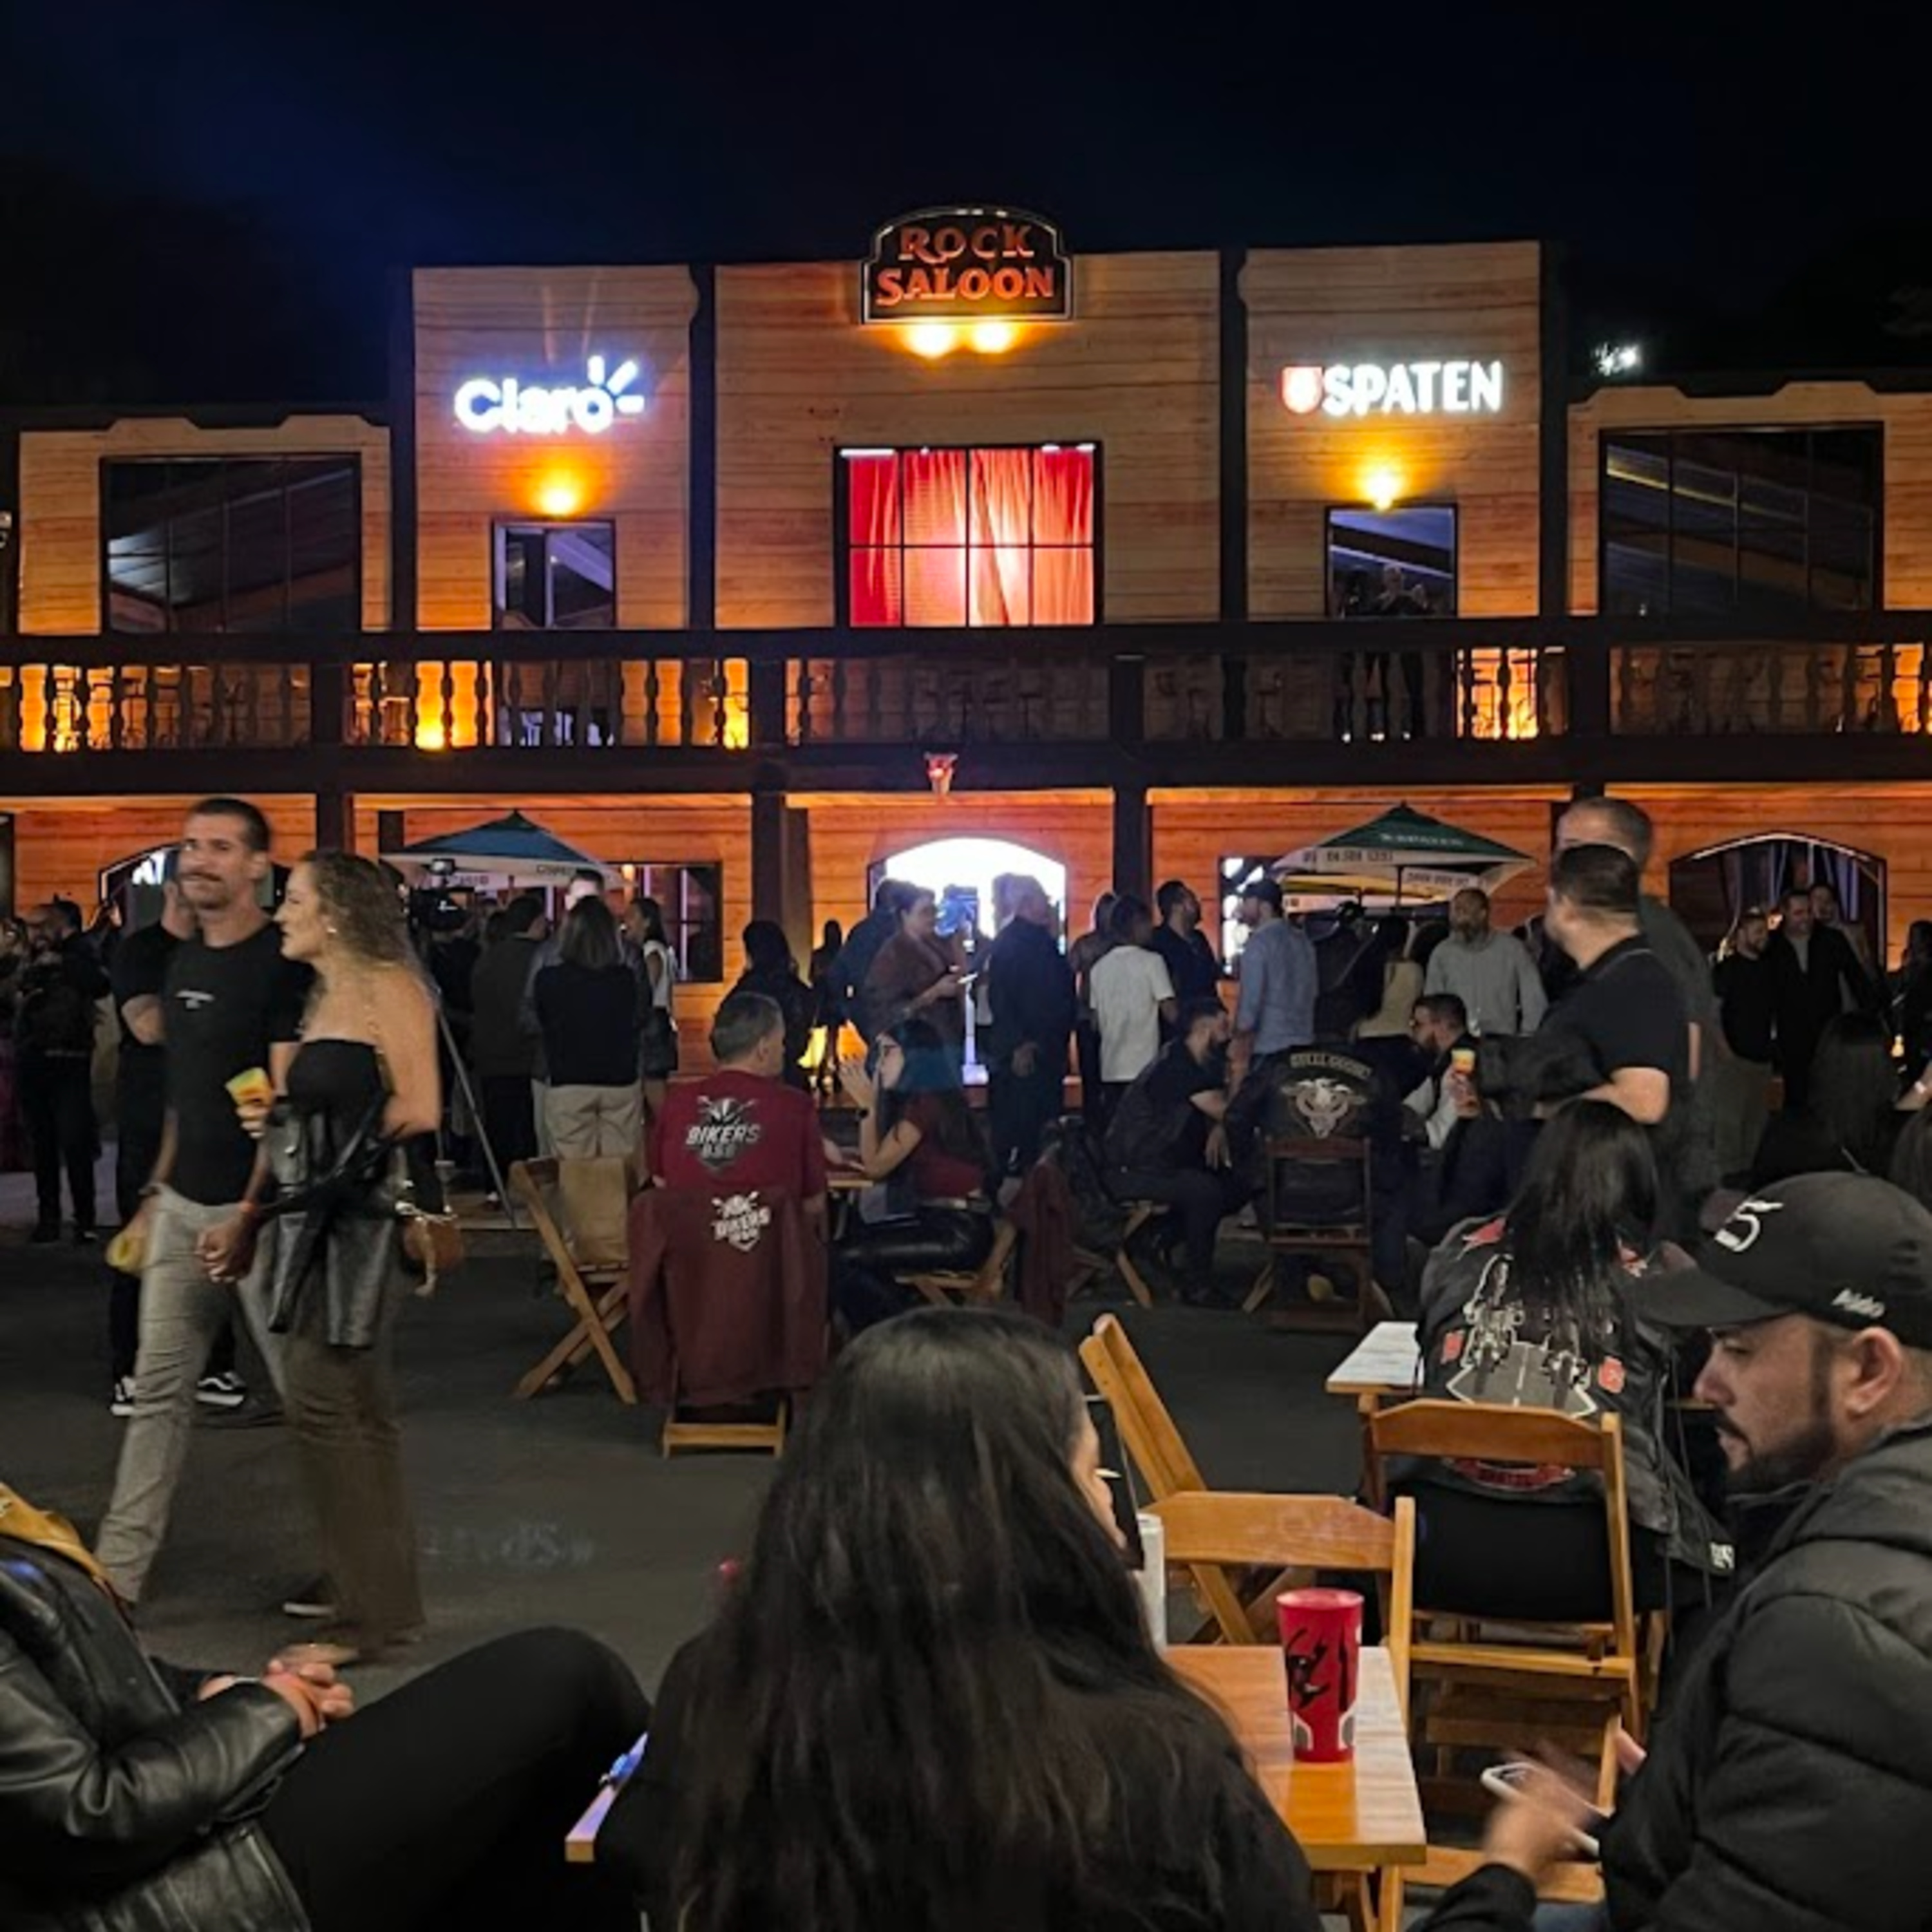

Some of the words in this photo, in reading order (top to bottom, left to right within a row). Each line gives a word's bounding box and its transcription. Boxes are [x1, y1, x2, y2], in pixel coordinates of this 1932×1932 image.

[898, 225, 1034, 263] ROCK
[876, 265, 1054, 307] SALOON
[453, 377, 614, 434] Claro
[1321, 361, 1504, 417] SPATEN
[686, 1124, 761, 1144] BIKERS
